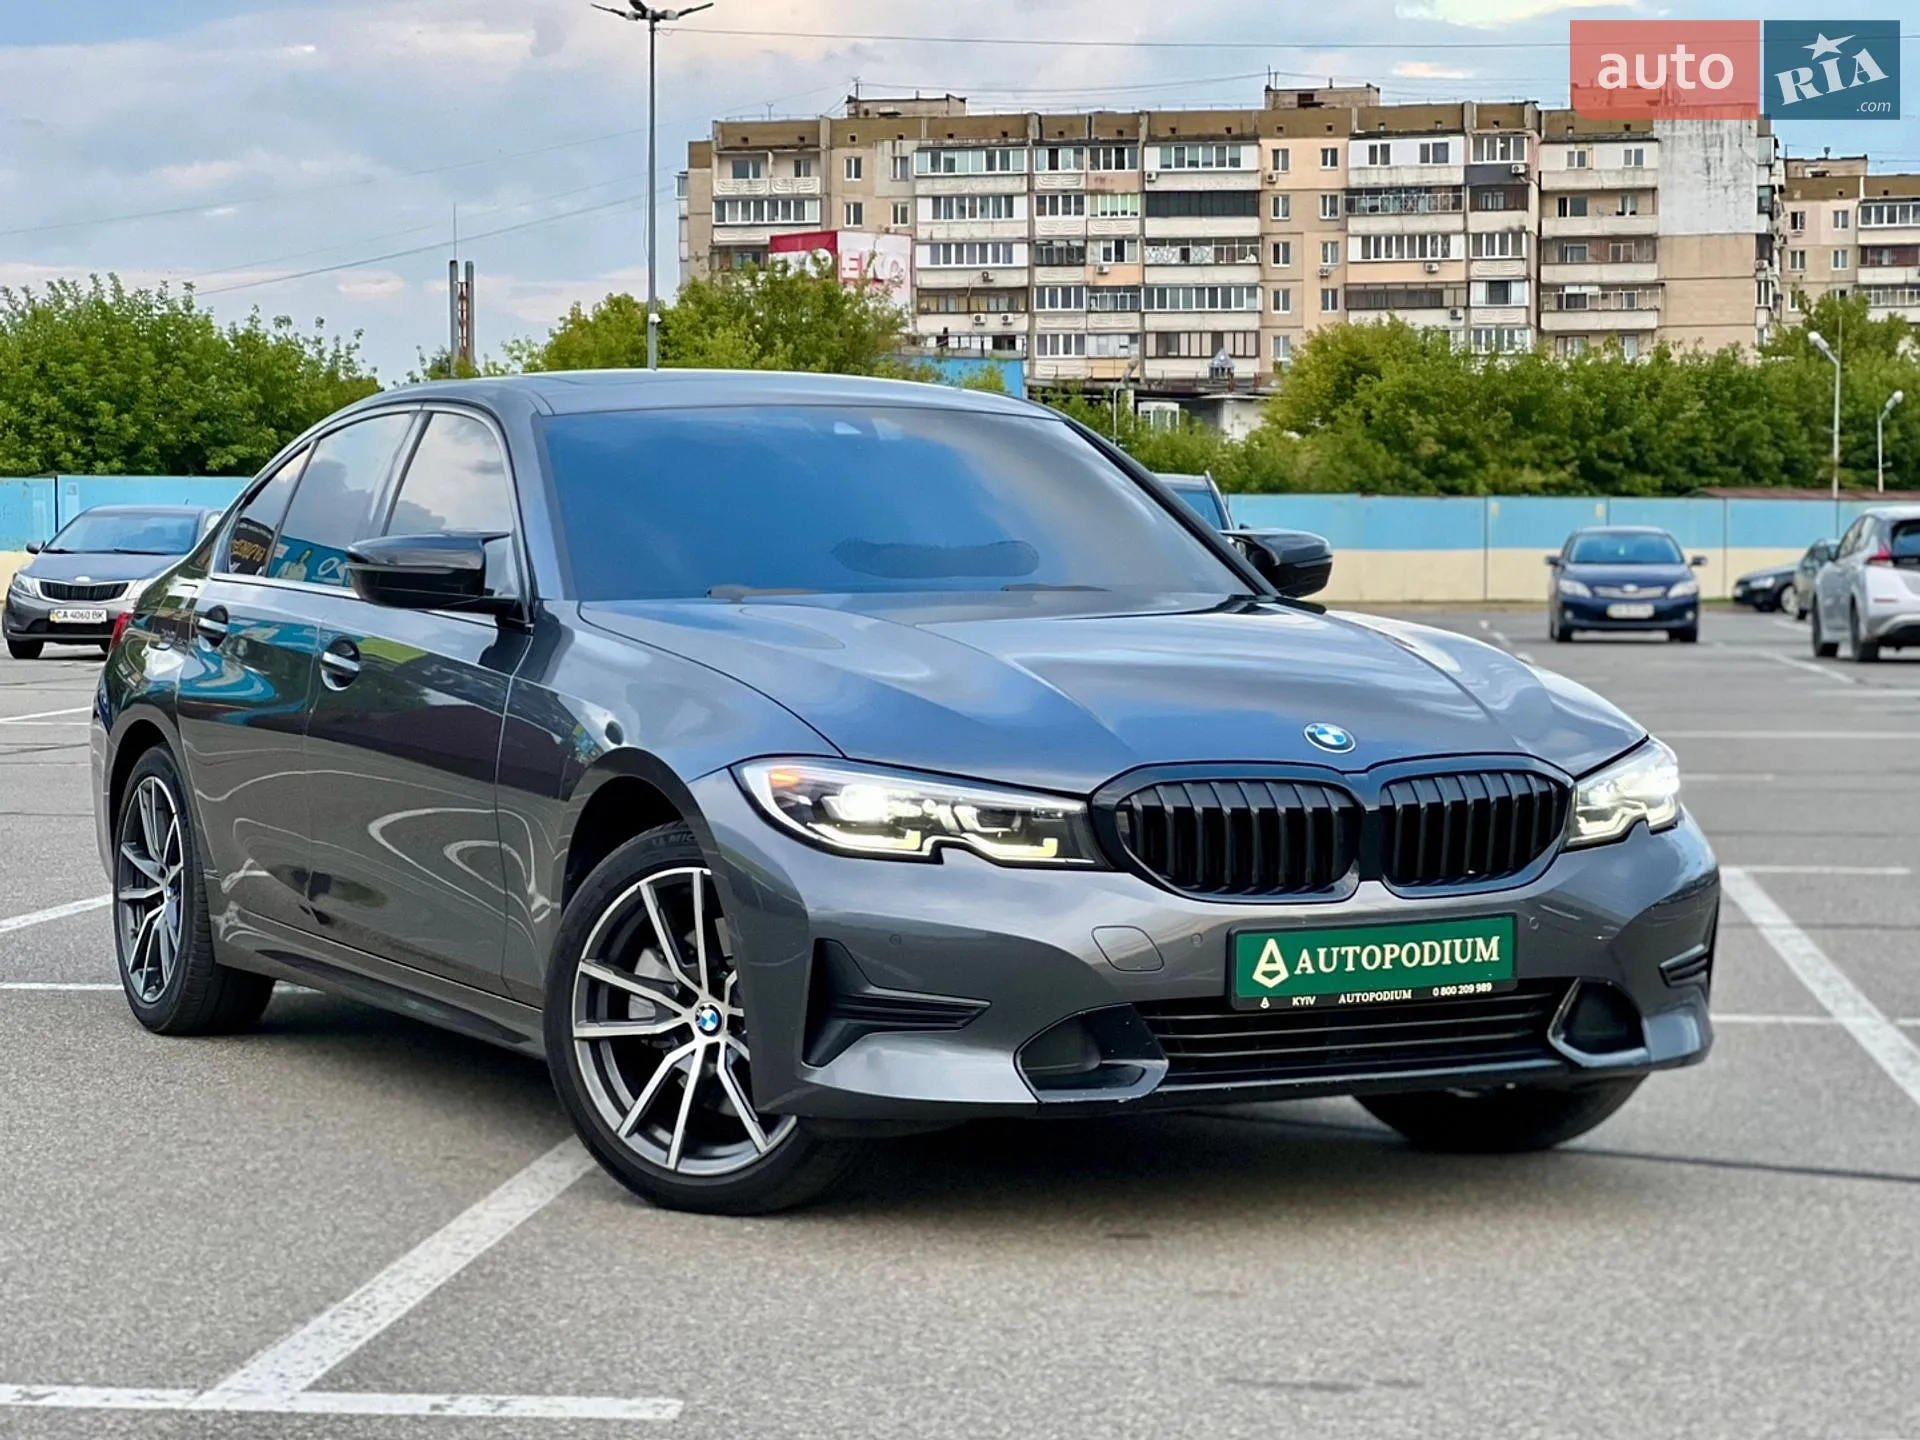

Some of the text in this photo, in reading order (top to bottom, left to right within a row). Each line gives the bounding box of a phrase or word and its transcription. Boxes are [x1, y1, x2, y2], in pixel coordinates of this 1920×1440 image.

[56, 610, 68, 619] CA
[70, 610, 90, 620] 4060
[1294, 936, 1500, 975] AUTOPODIUM
[1292, 996, 1316, 1006] KYIV
[1338, 989, 1412, 1004] AUTOPODIUM
[1432, 987, 1439, 997] 0
[1440, 985, 1457, 996] 800
[1458, 984, 1474, 995] 209
